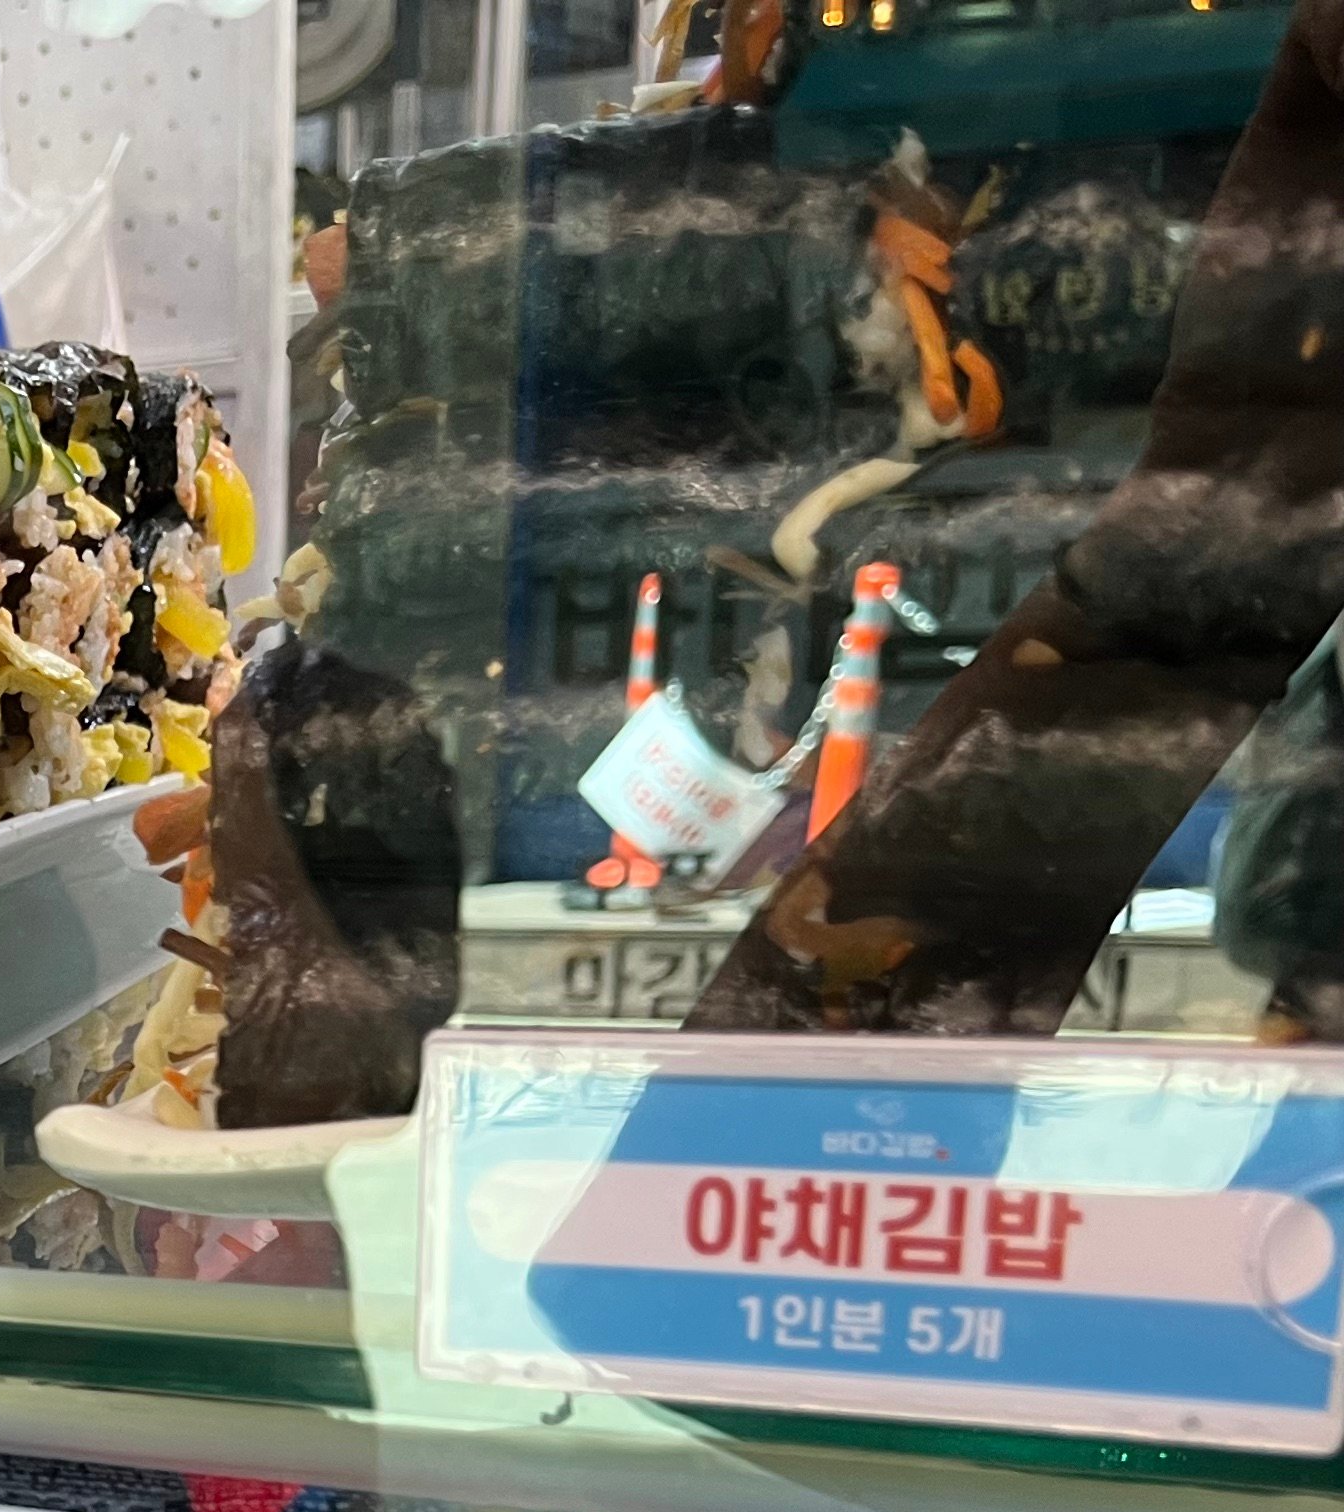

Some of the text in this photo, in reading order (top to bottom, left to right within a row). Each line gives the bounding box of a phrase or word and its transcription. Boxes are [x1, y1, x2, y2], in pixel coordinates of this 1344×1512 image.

[685, 1175, 1084, 1281] 야채김밥
[737, 1294, 1005, 1362] 1인분 5개
